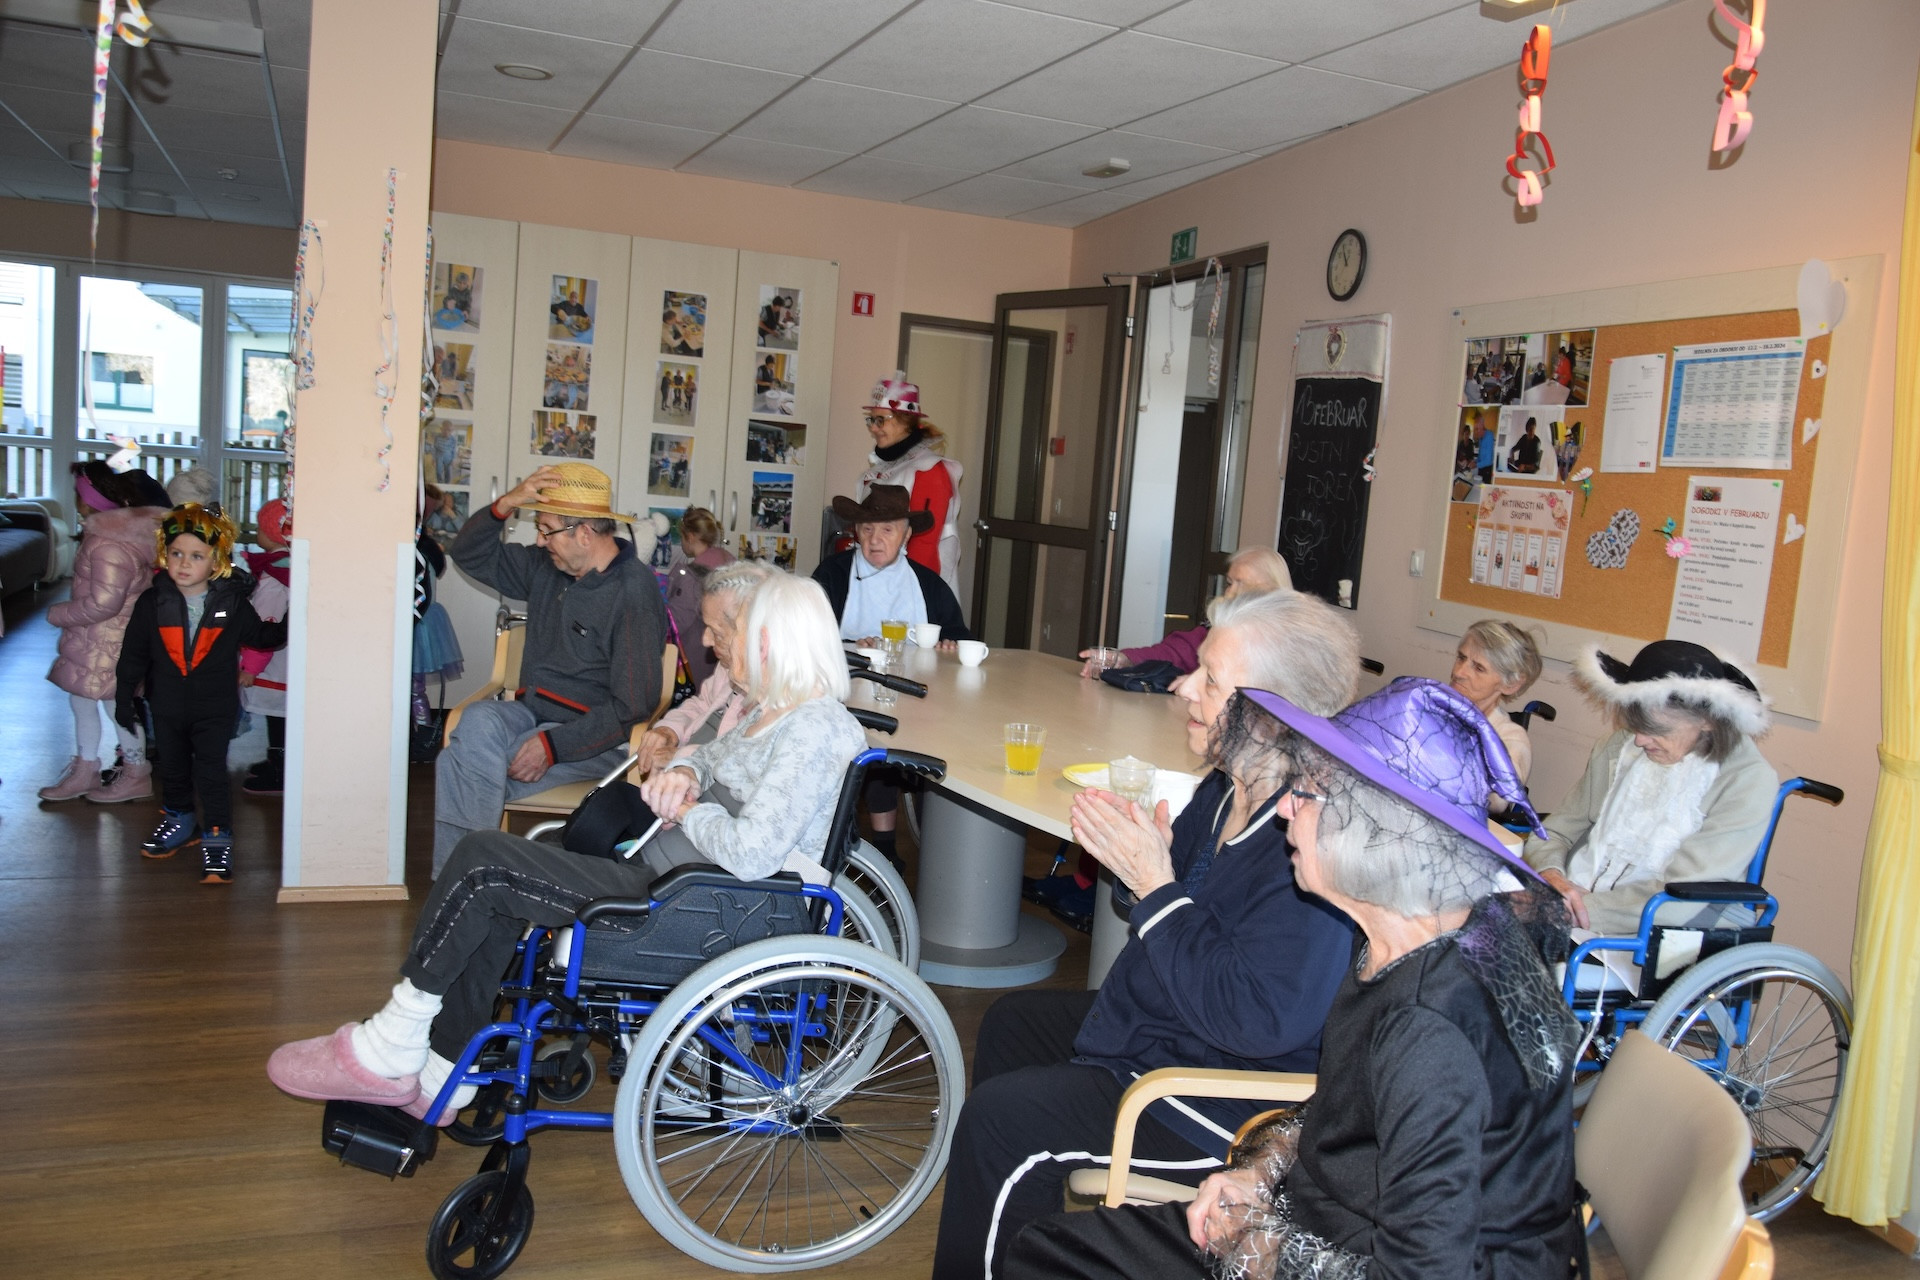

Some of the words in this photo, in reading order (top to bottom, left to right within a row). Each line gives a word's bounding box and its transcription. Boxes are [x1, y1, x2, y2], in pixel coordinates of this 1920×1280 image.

[1313, 397, 1368, 429] FEBRUAR
[1306, 468, 1358, 511] TOREK
[1502, 500, 1535, 510] AKTIVNOSTI
[1510, 511, 1533, 520] SKUPINI
[1691, 506, 1721, 516] DOGODKI
[1730, 509, 1770, 519] FEBRUARJU
